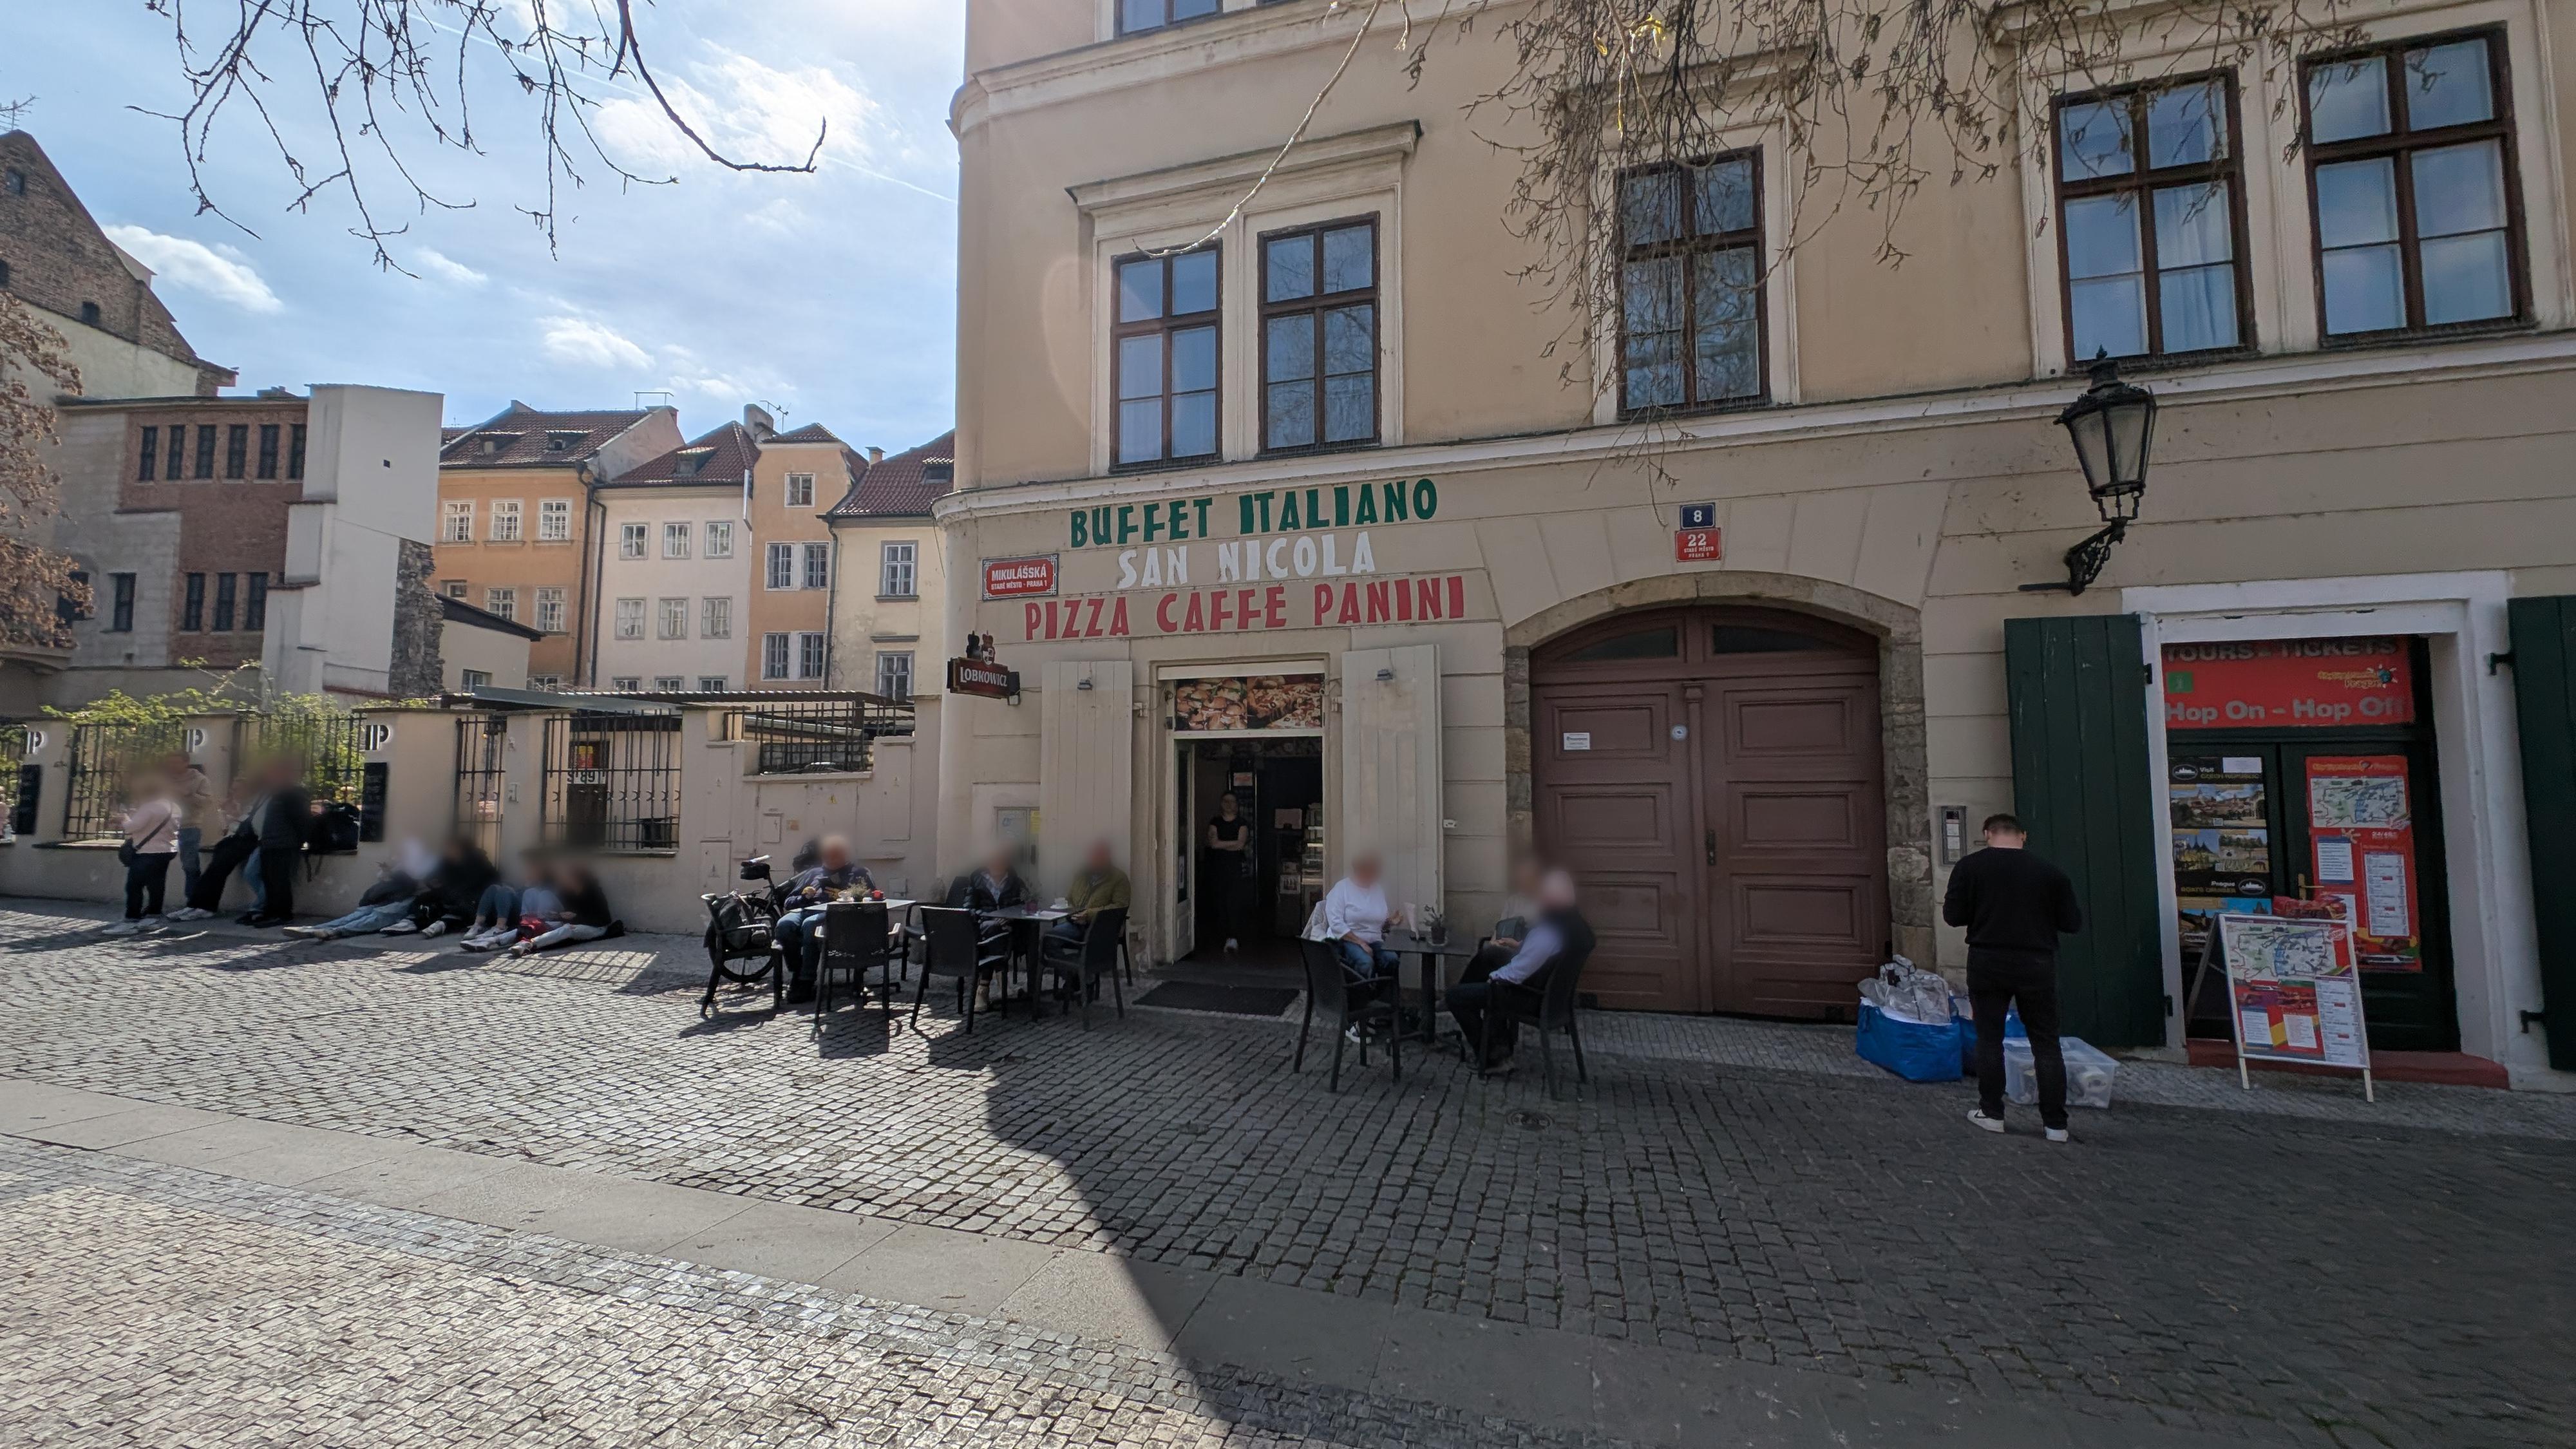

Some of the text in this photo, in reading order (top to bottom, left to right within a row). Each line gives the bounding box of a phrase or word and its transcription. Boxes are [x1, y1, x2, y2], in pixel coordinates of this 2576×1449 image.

[1070, 478, 1437, 548] BUFFET ITALIANO
[1694, 510, 1702, 522] 8
[1688, 533, 1707, 546] 22
[1117, 531, 1376, 589] SAN NICOLA
[992, 564, 1046, 581] MIKULÁŠSKÁ
[1024, 596, 1130, 641] PIZZA
[1314, 576, 1464, 627] PANINI
[959, 666, 1008, 687] LOBKOWICZ
[2164, 701, 2218, 724] Hop
[2226, 700, 2266, 720] On
[2292, 697, 2352, 721] Hop
